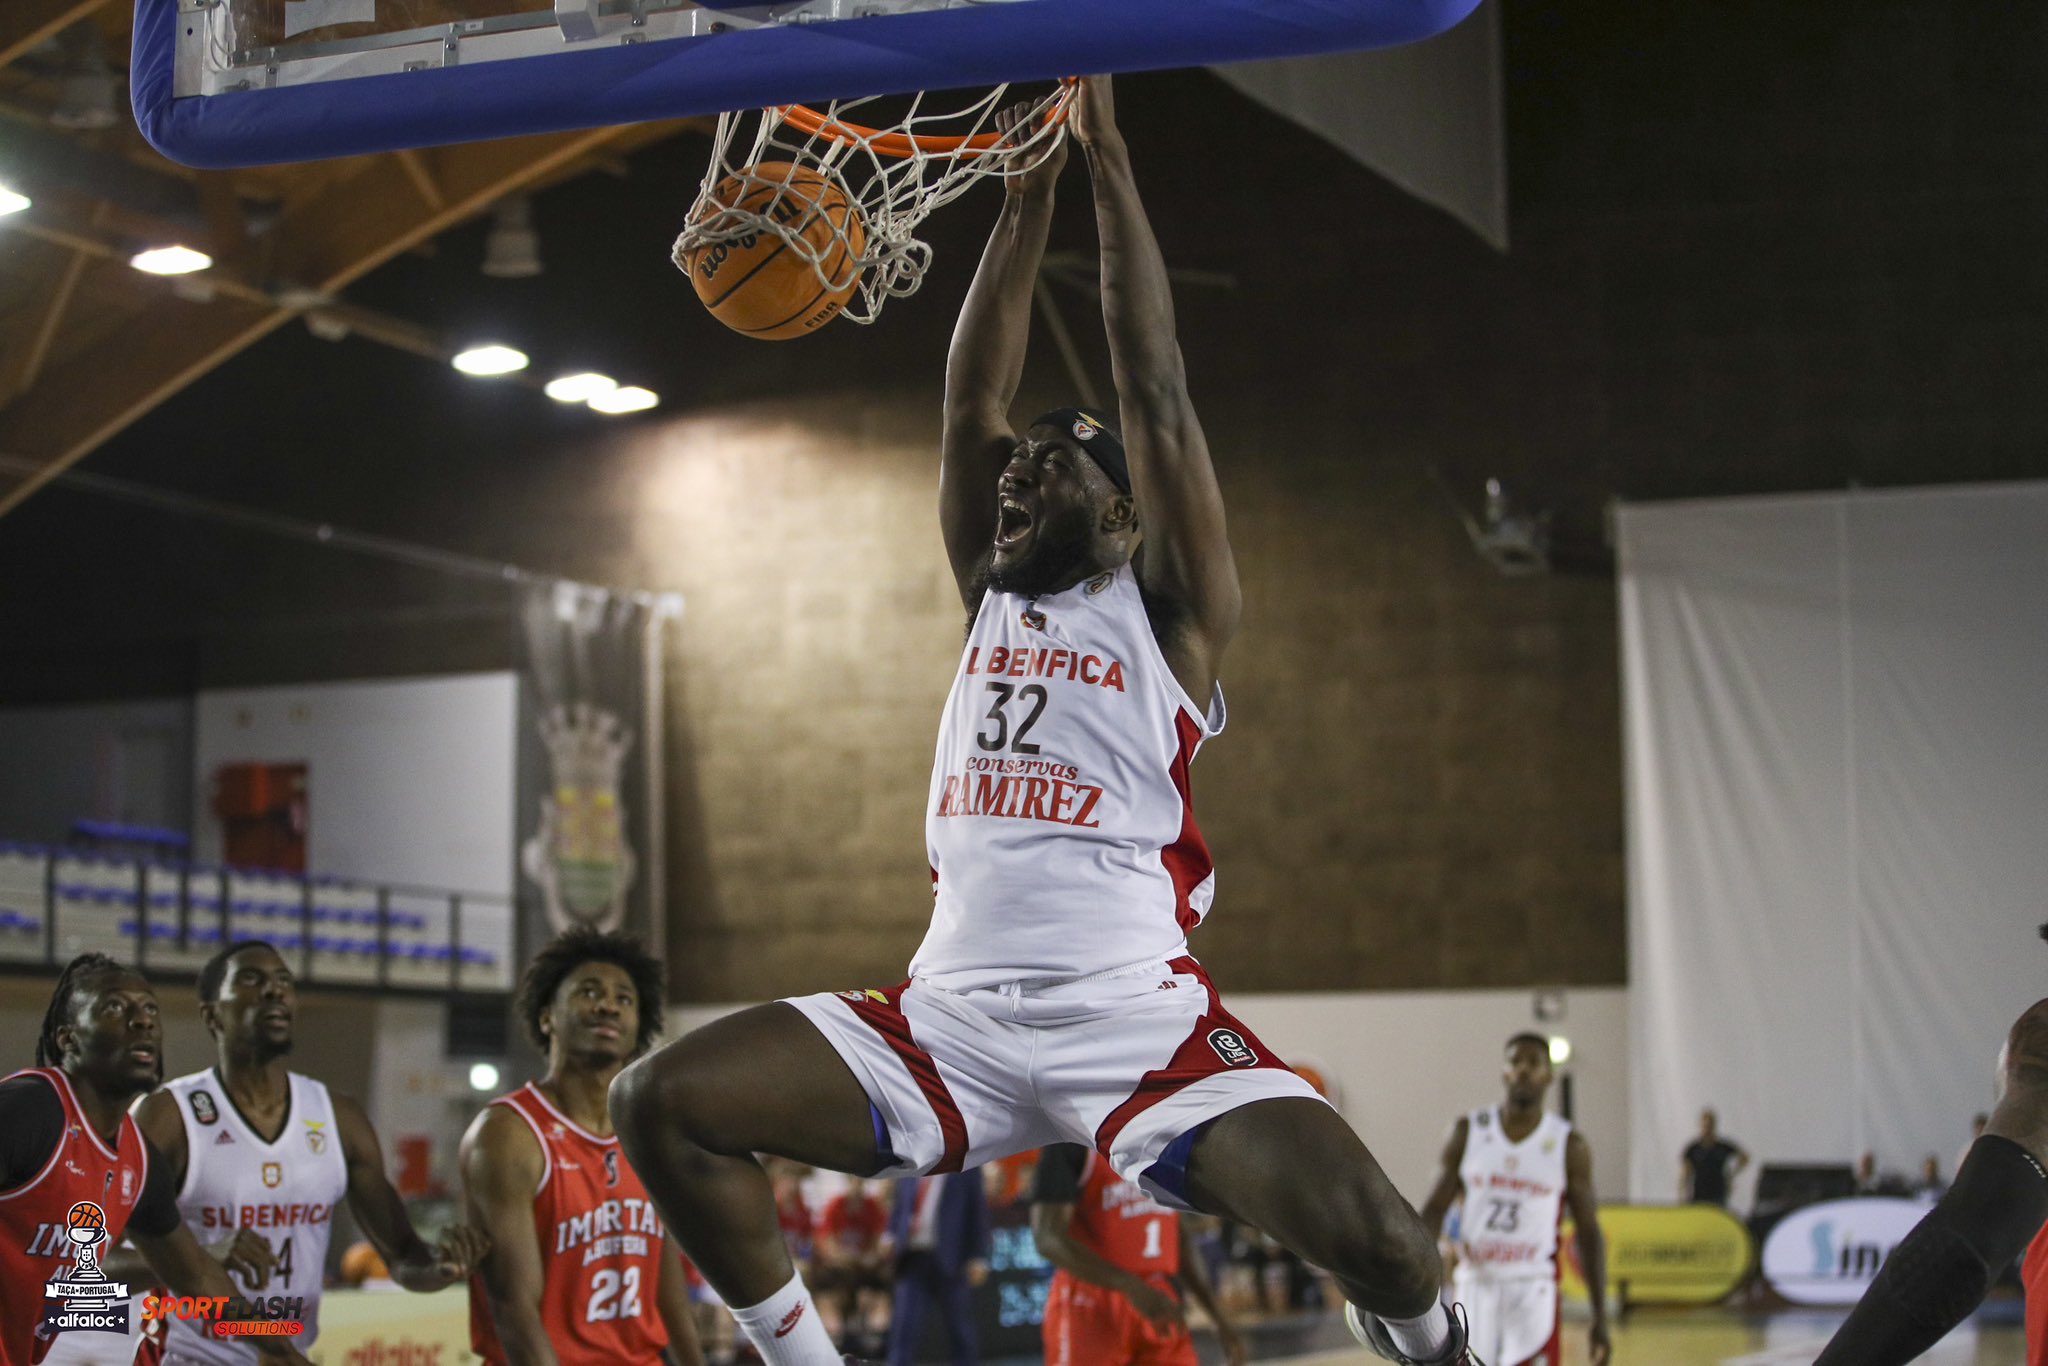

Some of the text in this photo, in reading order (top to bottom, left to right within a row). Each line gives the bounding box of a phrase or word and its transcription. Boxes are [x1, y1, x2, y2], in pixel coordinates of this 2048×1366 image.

[804, 302, 839, 328] FIBA
[986, 646, 1125, 692] BENFICA
[977, 681, 1048, 755] 32
[966, 756, 1079, 780] conservas
[936, 772, 1103, 828] RAMIREZ
[202, 1206, 233, 1228] SL
[1486, 1199, 1521, 1232] 23
[1142, 1219, 1162, 1259] 1
[586, 1265, 642, 1323] 22
